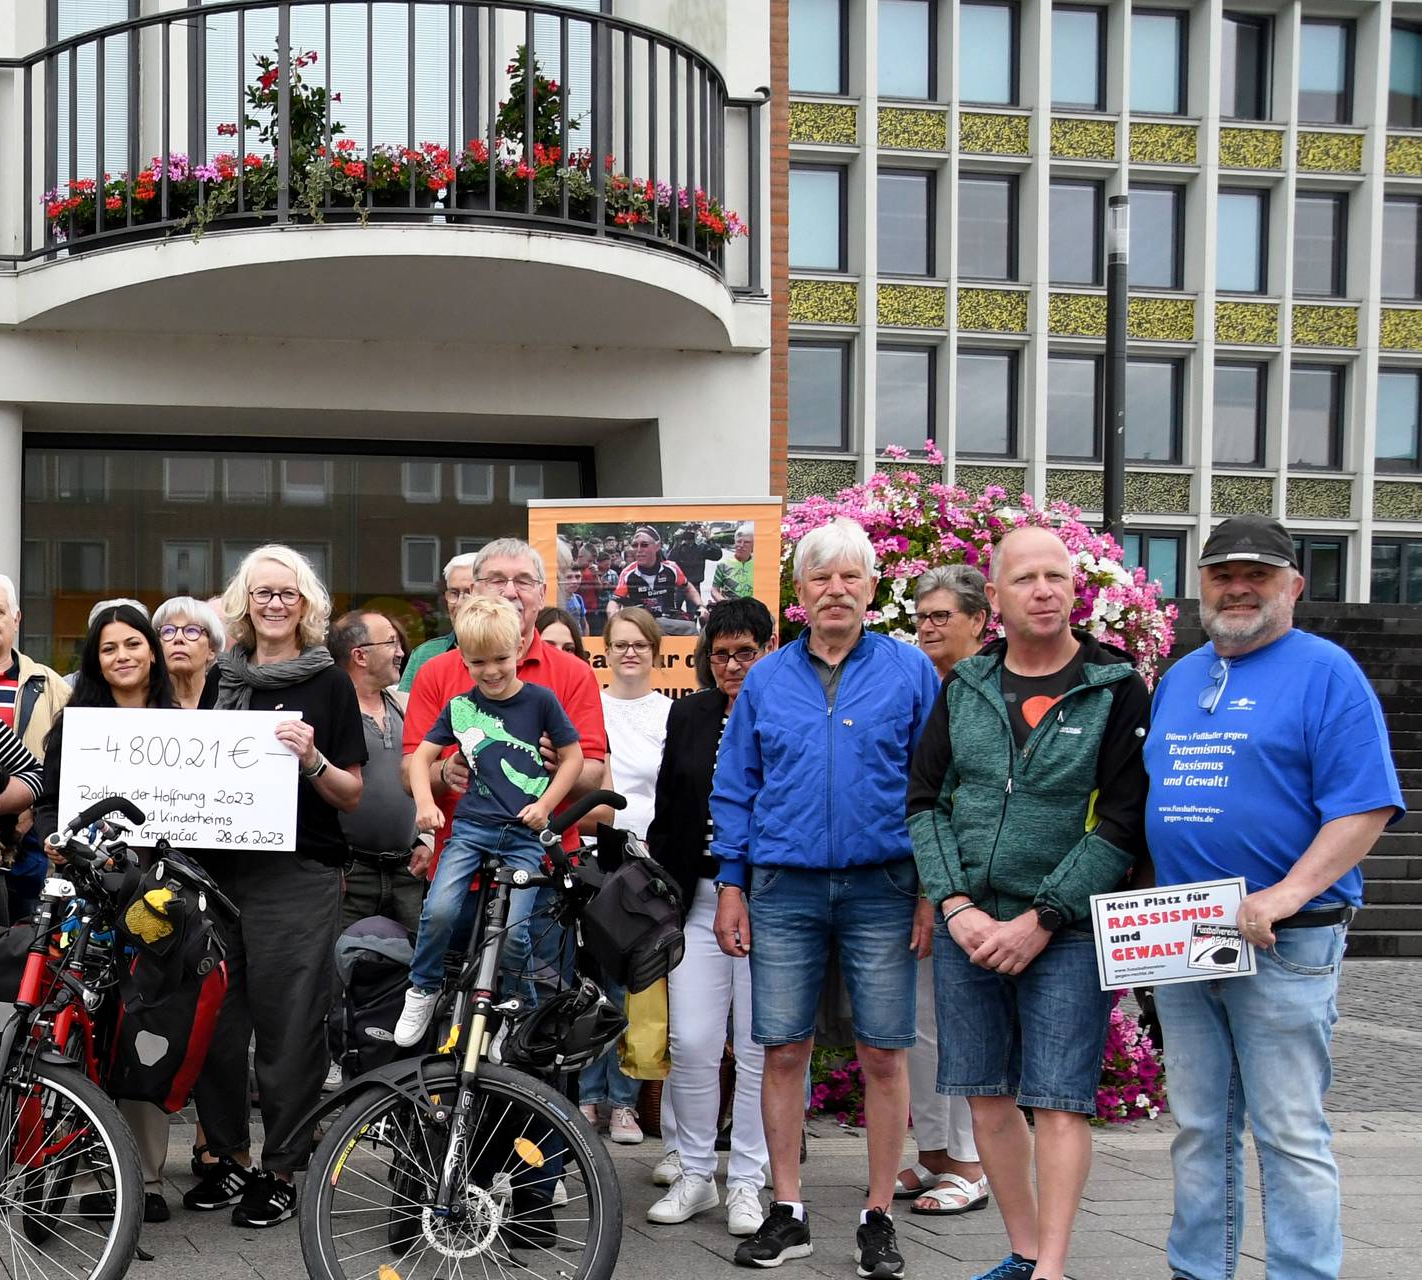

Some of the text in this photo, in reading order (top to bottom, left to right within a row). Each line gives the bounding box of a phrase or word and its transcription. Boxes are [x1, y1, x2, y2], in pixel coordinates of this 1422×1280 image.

[1165, 732, 1187, 741] Düren
[1223, 731, 1248, 740] gegen
[1169, 744, 1236, 756] Extremismus,
[1172, 760, 1224, 771] Rassismus
[1163, 776, 1183, 786] und
[130, 787, 151, 801] der
[152, 785, 206, 808] Hoffnung
[213, 790, 255, 806] 2023
[215, 829, 285, 846] 28.06.2023
[1106, 891, 1210, 911] Kein Platz für
[1107, 904, 1225, 930] RASSISMUS
[1110, 930, 1141, 944] und
[1111, 941, 1185, 962] GEWALT
